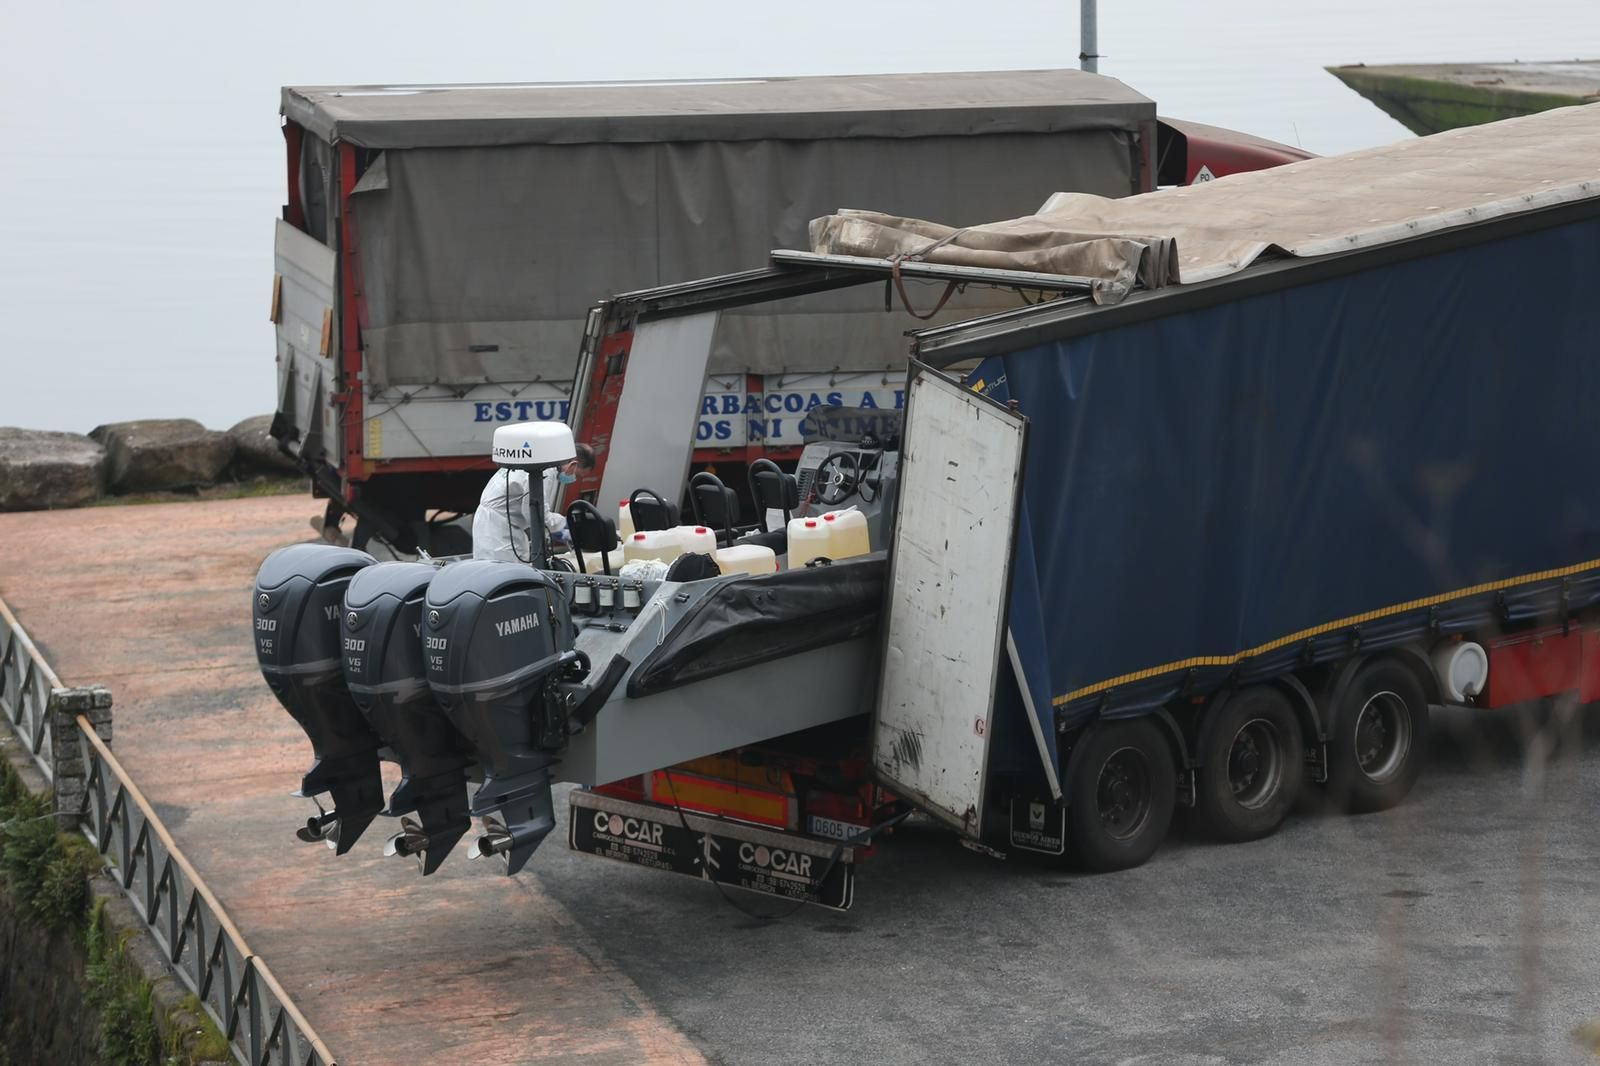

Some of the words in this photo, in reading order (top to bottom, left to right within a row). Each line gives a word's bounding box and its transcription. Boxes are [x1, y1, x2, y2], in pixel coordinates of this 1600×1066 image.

[859, 391, 878, 409] A
[750, 418, 782, 441] NI
[493, 448, 532, 458] ARMIN
[256, 617, 277, 632] 300
[495, 612, 540, 637] YAMAHA
[260, 638, 273, 648] V6
[344, 638, 366, 652] 300
[426, 636, 448, 650] 300
[348, 656, 361, 667] V6
[430, 655, 444, 665] V6
[975, 718, 985, 735] G
[594, 811, 664, 845] COCAR
[815, 819, 844, 838] 0605
[739, 842, 812, 877] COCAR
